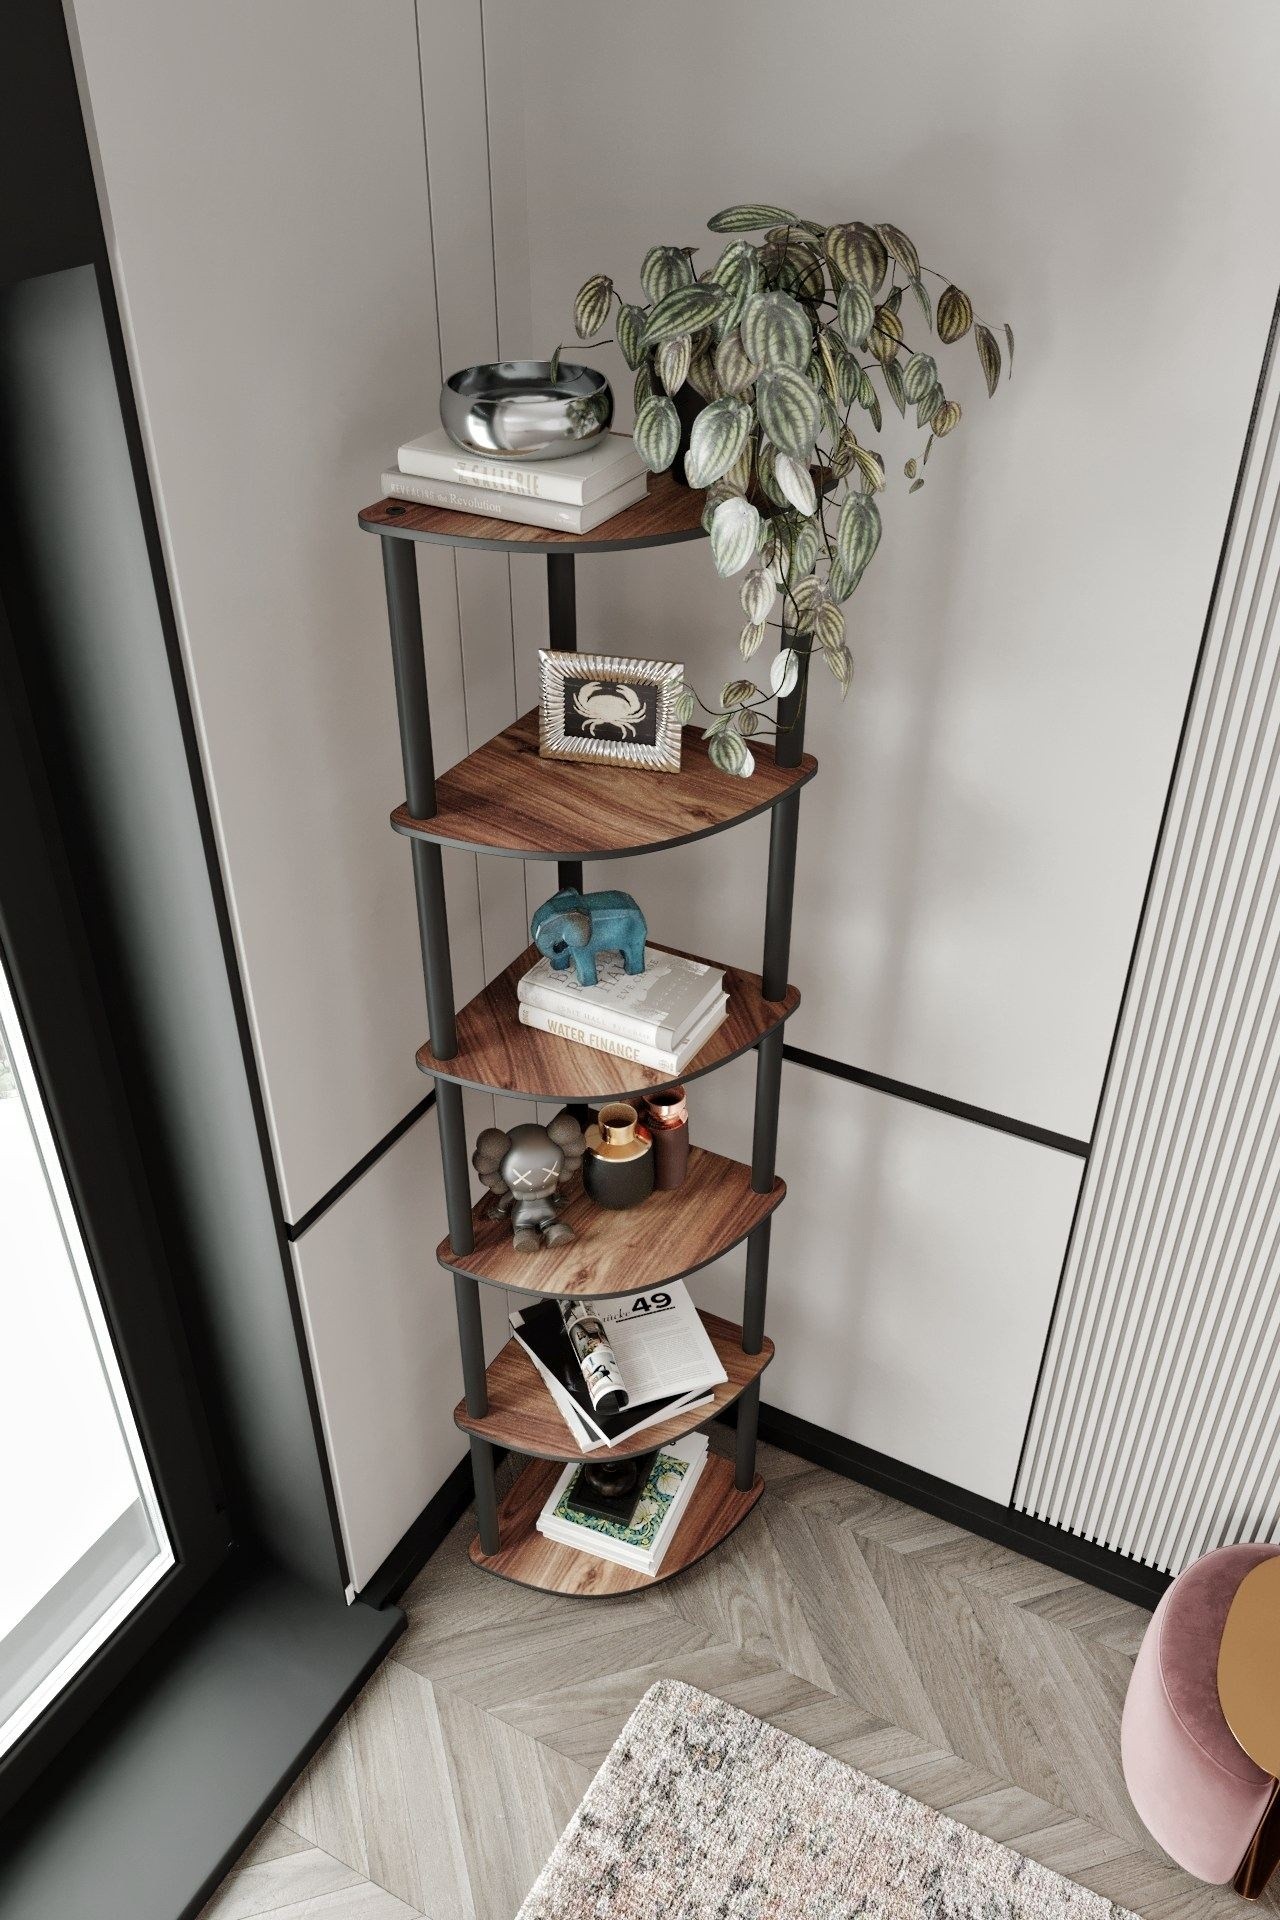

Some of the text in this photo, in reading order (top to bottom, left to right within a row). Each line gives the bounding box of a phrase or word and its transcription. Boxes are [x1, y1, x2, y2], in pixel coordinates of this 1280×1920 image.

[449, 492, 502, 513] Revolution
[547, 1017, 586, 1042] WATER
[588, 1033, 641, 1063] FINANCE
[631, 1292, 672, 1313] 49
